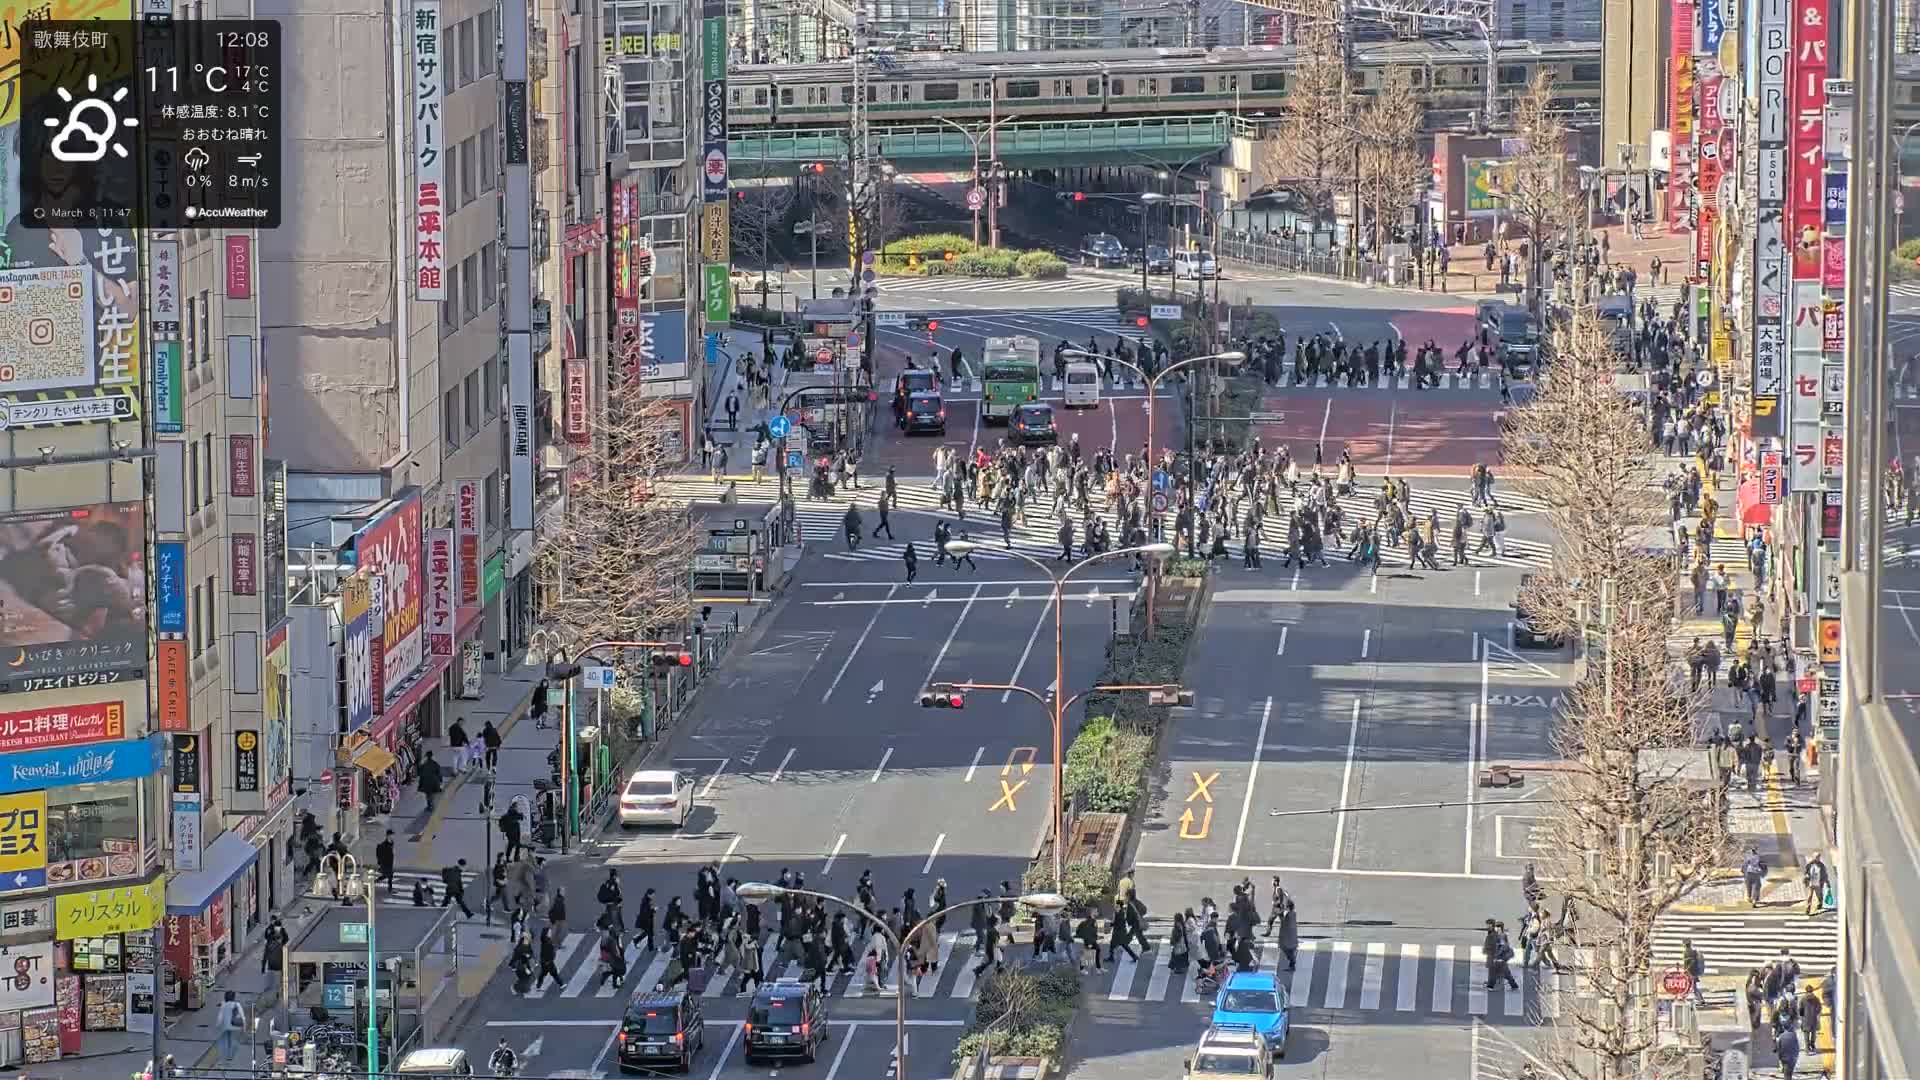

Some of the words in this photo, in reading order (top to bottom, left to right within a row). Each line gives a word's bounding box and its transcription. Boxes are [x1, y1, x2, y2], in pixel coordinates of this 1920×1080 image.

[416, 9, 438, 168] 新宿サンパーク
[1704, 86, 1717, 119] アコム
[707, 159, 725, 175] 薬
[1768, 151, 1777, 198] ESOLA
[418, 182, 441, 289] 三平本館
[711, 207, 723, 260] 肉汁水餃子
[711, 273, 722, 311] レイク
[158, 322, 175, 332] 3F
[1760, 327, 1773, 379] 大衆酒場
[157, 351, 168, 411] FamilyMart
[1794, 305, 1821, 466] パセラ
[14, 406, 48, 418] テンクリ
[53, 401, 114, 417] たいせい先生
[460, 485, 471, 529] GAME
[433, 540, 449, 626] 三平ストア
[109, 708, 119, 732] 5F
[24, 731, 69, 745] RESTAURANT
[0, 808, 39, 832] プロ
[0, 832, 39, 855] ミス
[4, 909, 38, 929] 囲碁
[69, 901, 141, 925] クリスタル
[331, 960, 384, 969] SUBNAE
[327, 989, 342, 1001] 12
